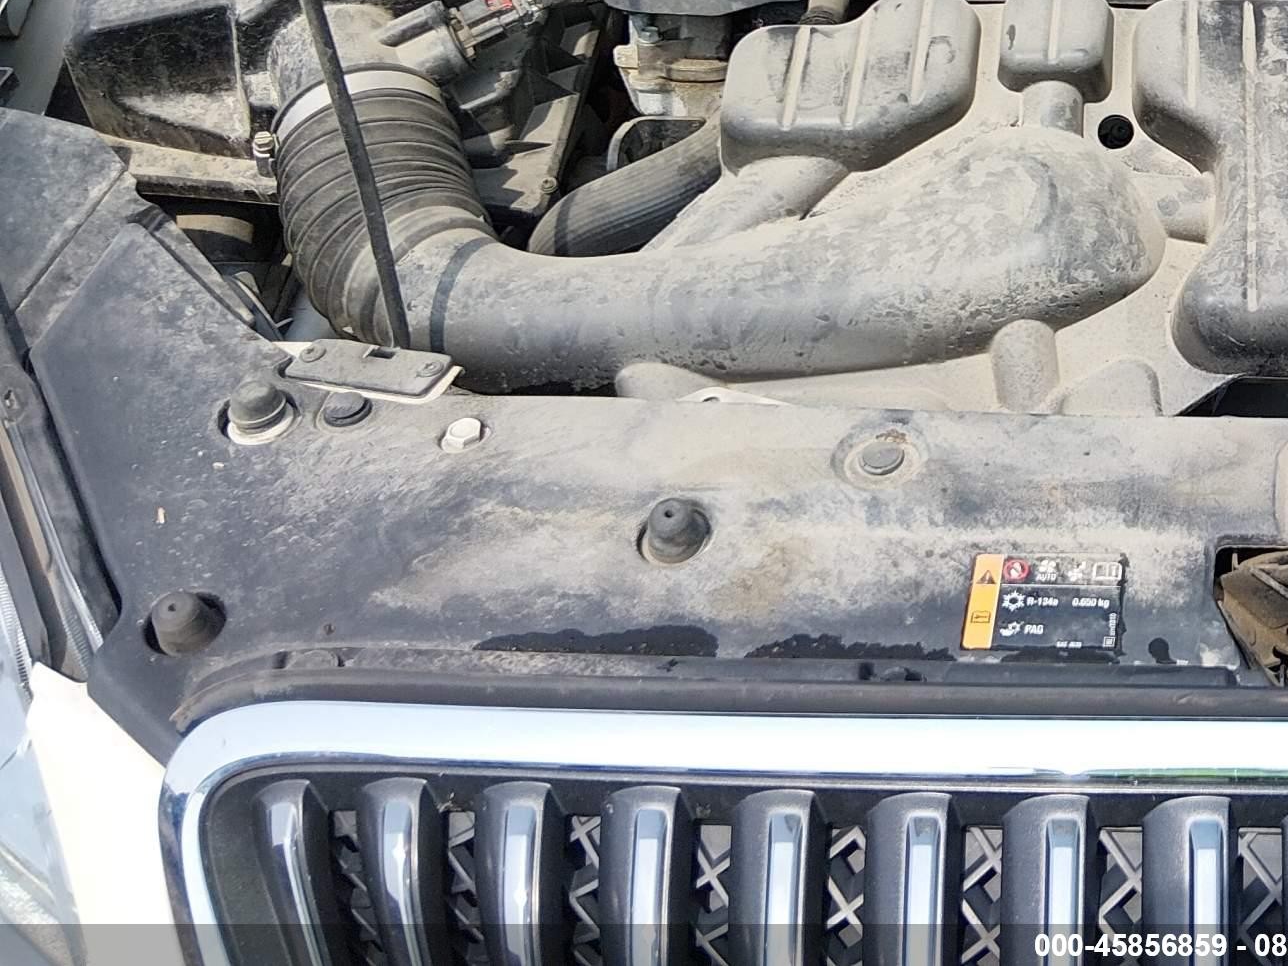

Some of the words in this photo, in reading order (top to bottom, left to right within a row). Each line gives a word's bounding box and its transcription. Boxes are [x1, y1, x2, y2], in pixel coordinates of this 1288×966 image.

[1035, 573, 1057, 582] AUTO
[1026, 596, 1059, 607] R-134a
[1097, 597, 1110, 610] kg
